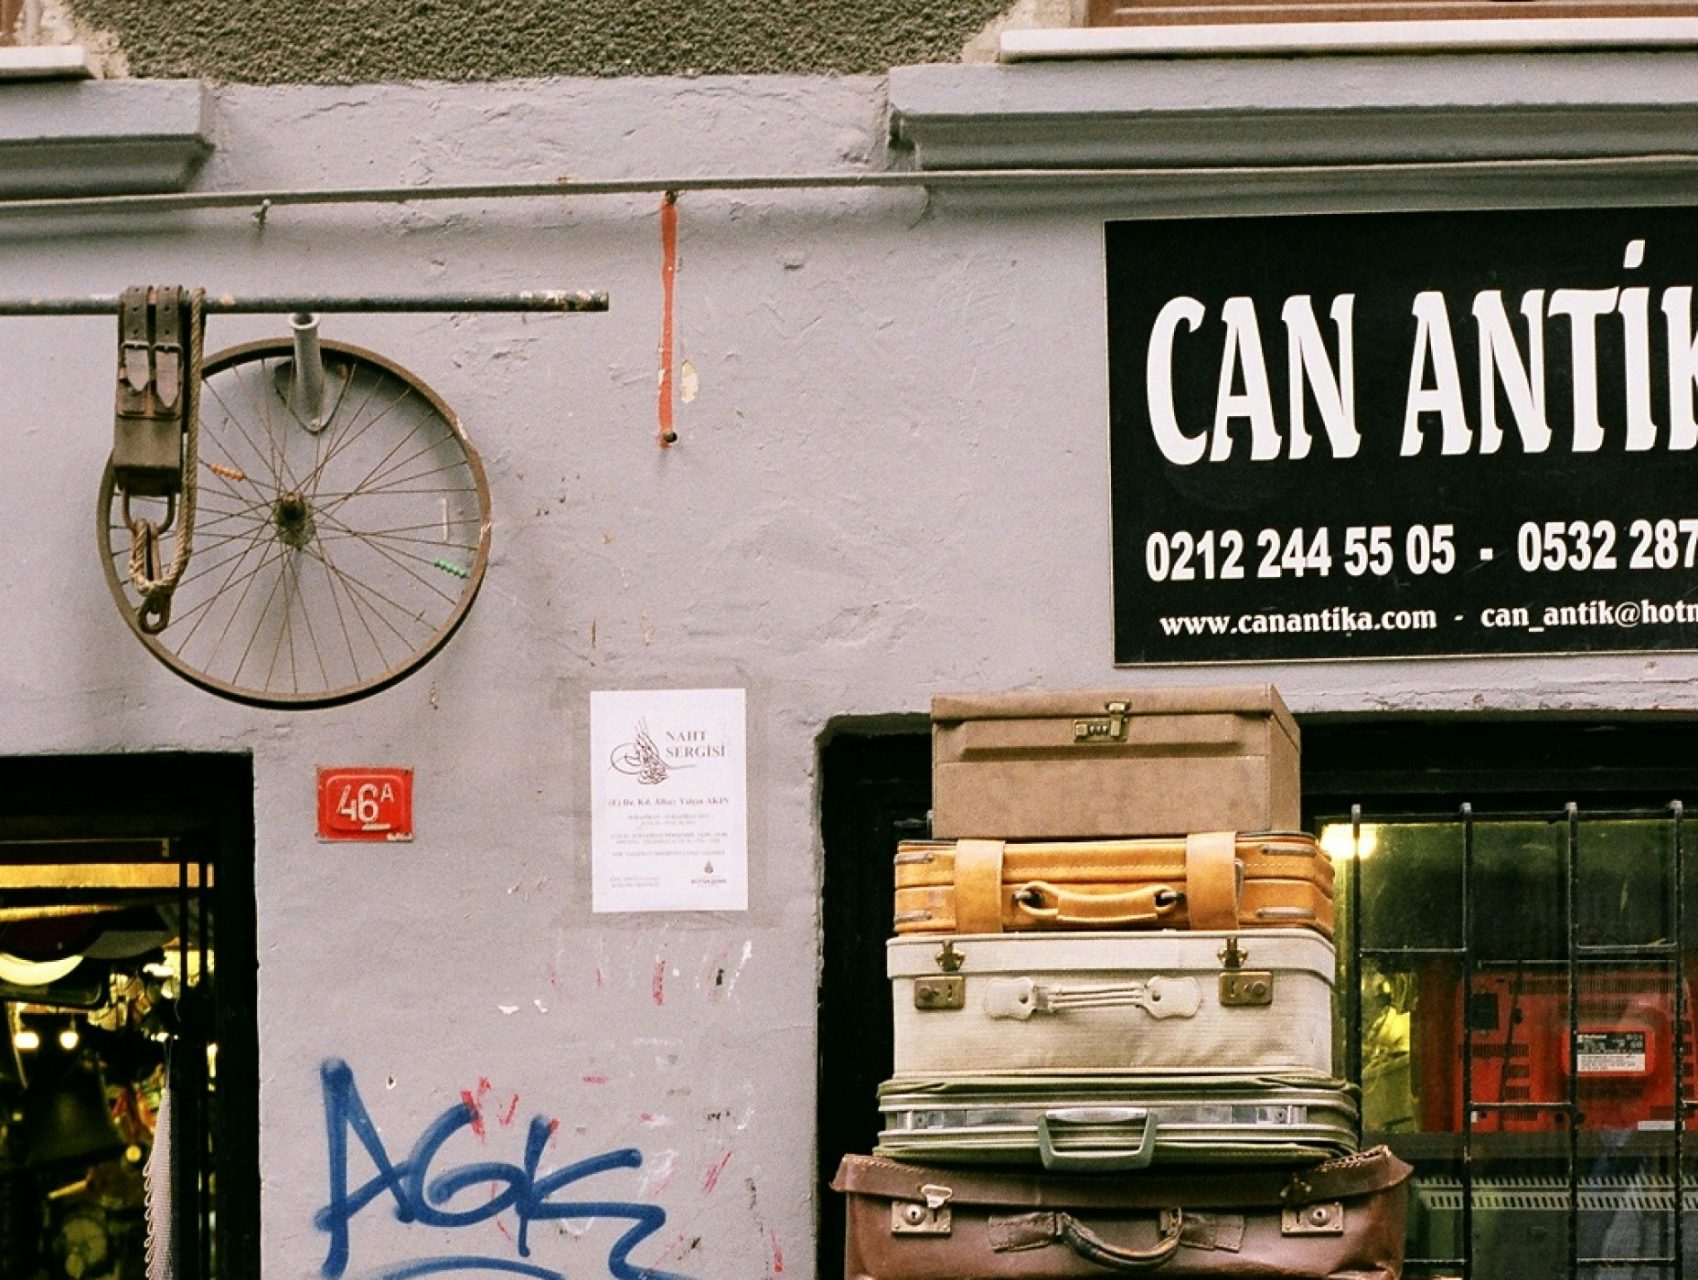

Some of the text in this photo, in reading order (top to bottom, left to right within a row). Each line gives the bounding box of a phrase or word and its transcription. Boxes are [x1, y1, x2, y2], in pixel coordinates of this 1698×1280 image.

[1146, 293, 1362, 466] CAN
[1145, 529, 1245, 582] 0212
[1256, 526, 1332, 578] 244
[1344, 525, 1394, 577] 55
[1405, 523, 1456, 575] 05
[1517, 519, 1618, 572] 0532
[1629, 518, 1698, 570] 287
[1159, 606, 1437, 636] www.canantika.com
